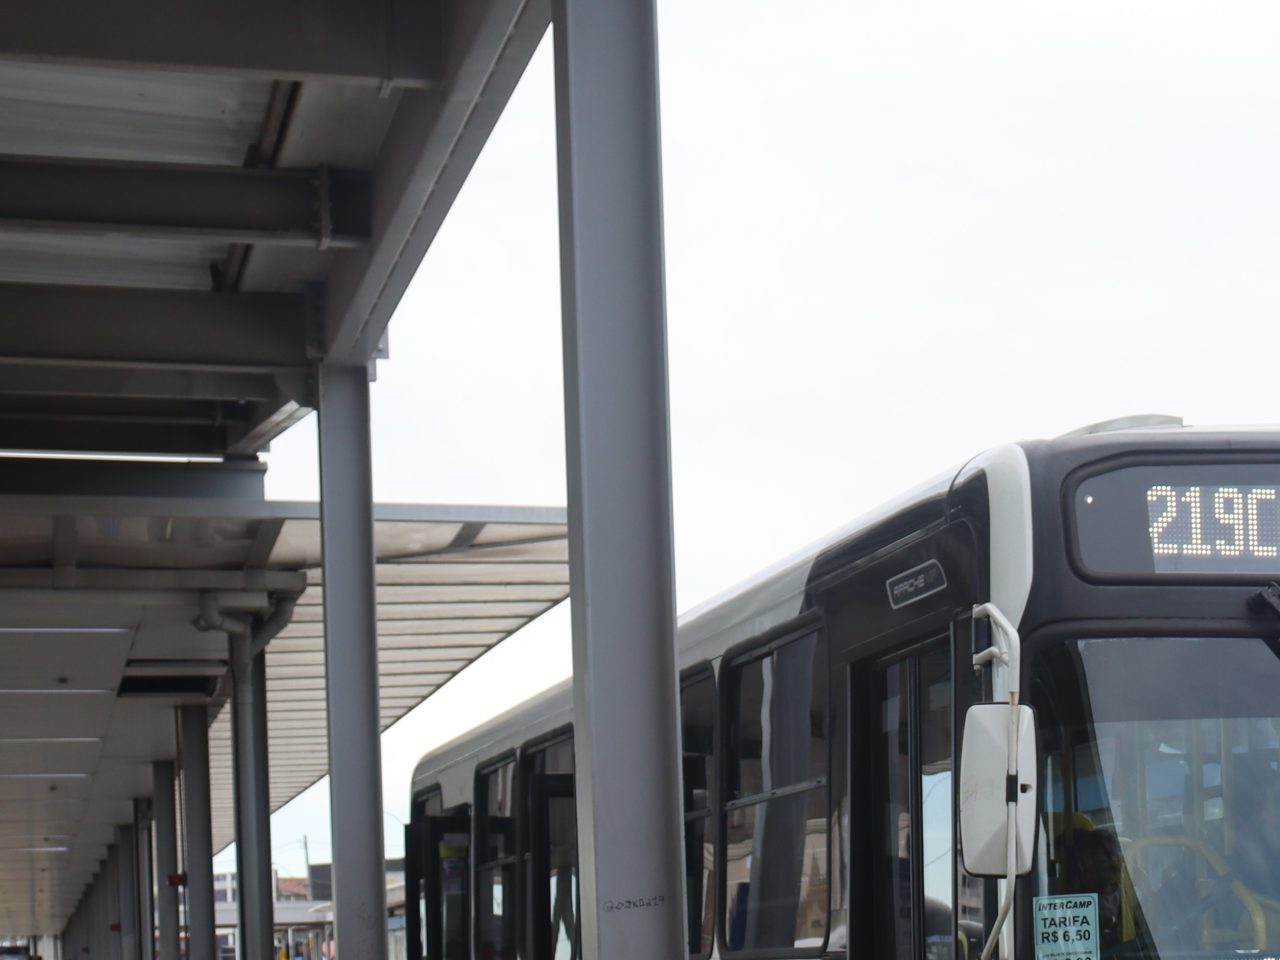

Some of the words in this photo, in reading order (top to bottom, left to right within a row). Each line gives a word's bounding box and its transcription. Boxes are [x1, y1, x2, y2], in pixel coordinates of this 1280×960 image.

[1041, 915, 1090, 928] TARIFA
[1042, 931, 1059, 943] R$
[1063, 929, 1091, 943] 6,50
